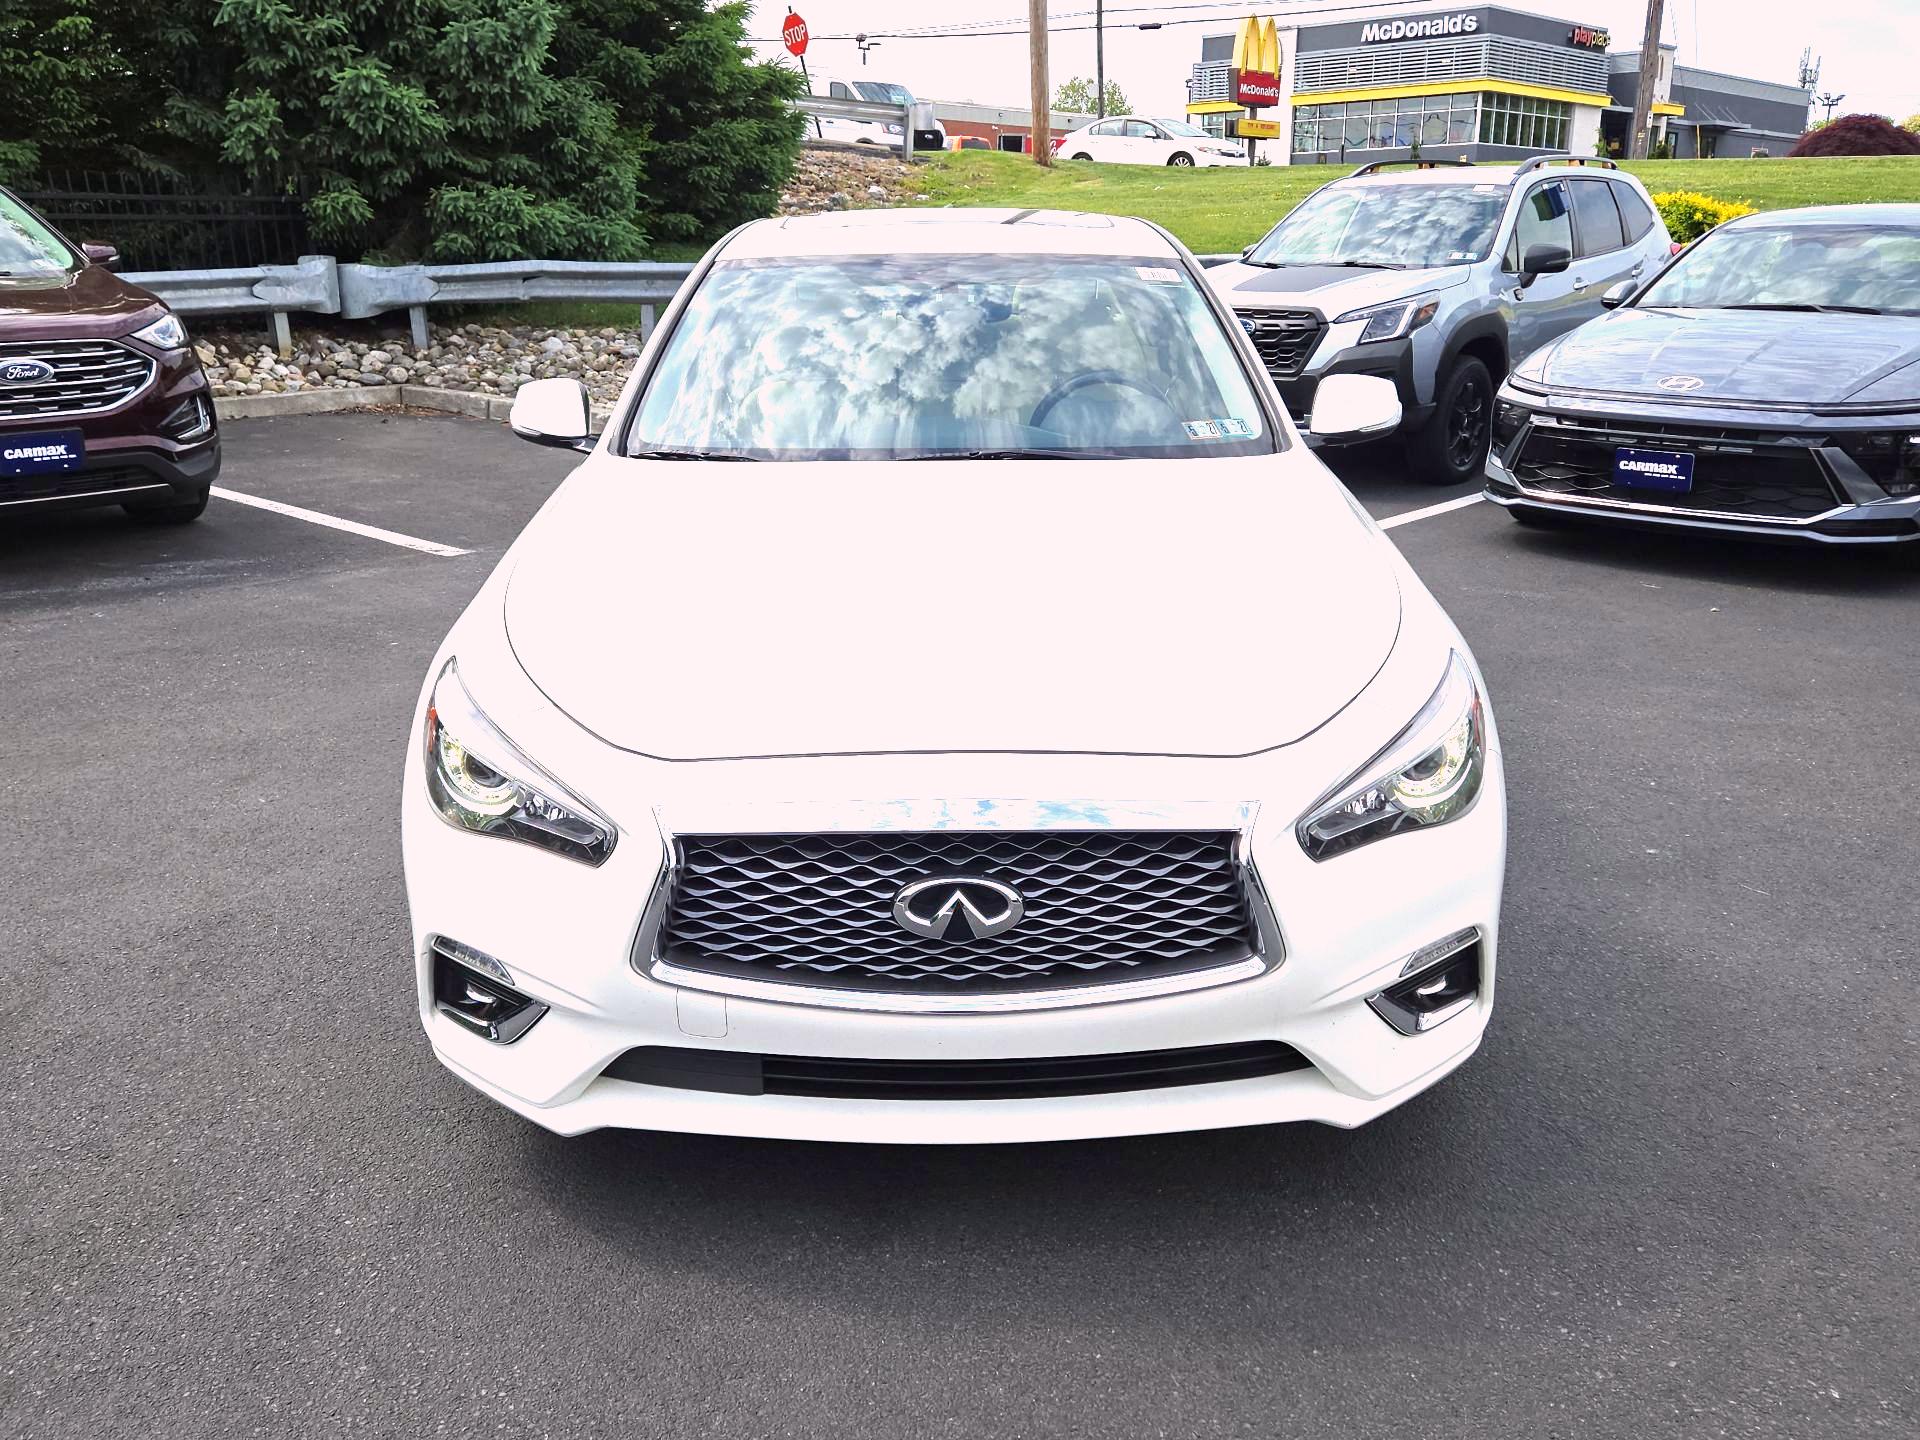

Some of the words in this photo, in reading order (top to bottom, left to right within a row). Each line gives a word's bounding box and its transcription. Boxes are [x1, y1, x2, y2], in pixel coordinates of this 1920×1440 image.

[784, 24, 806, 46] STOP
[1361, 14, 1478, 42] McDonald's
[1240, 83, 1279, 97] McDonald's
[7, 366, 40, 379] Ford
